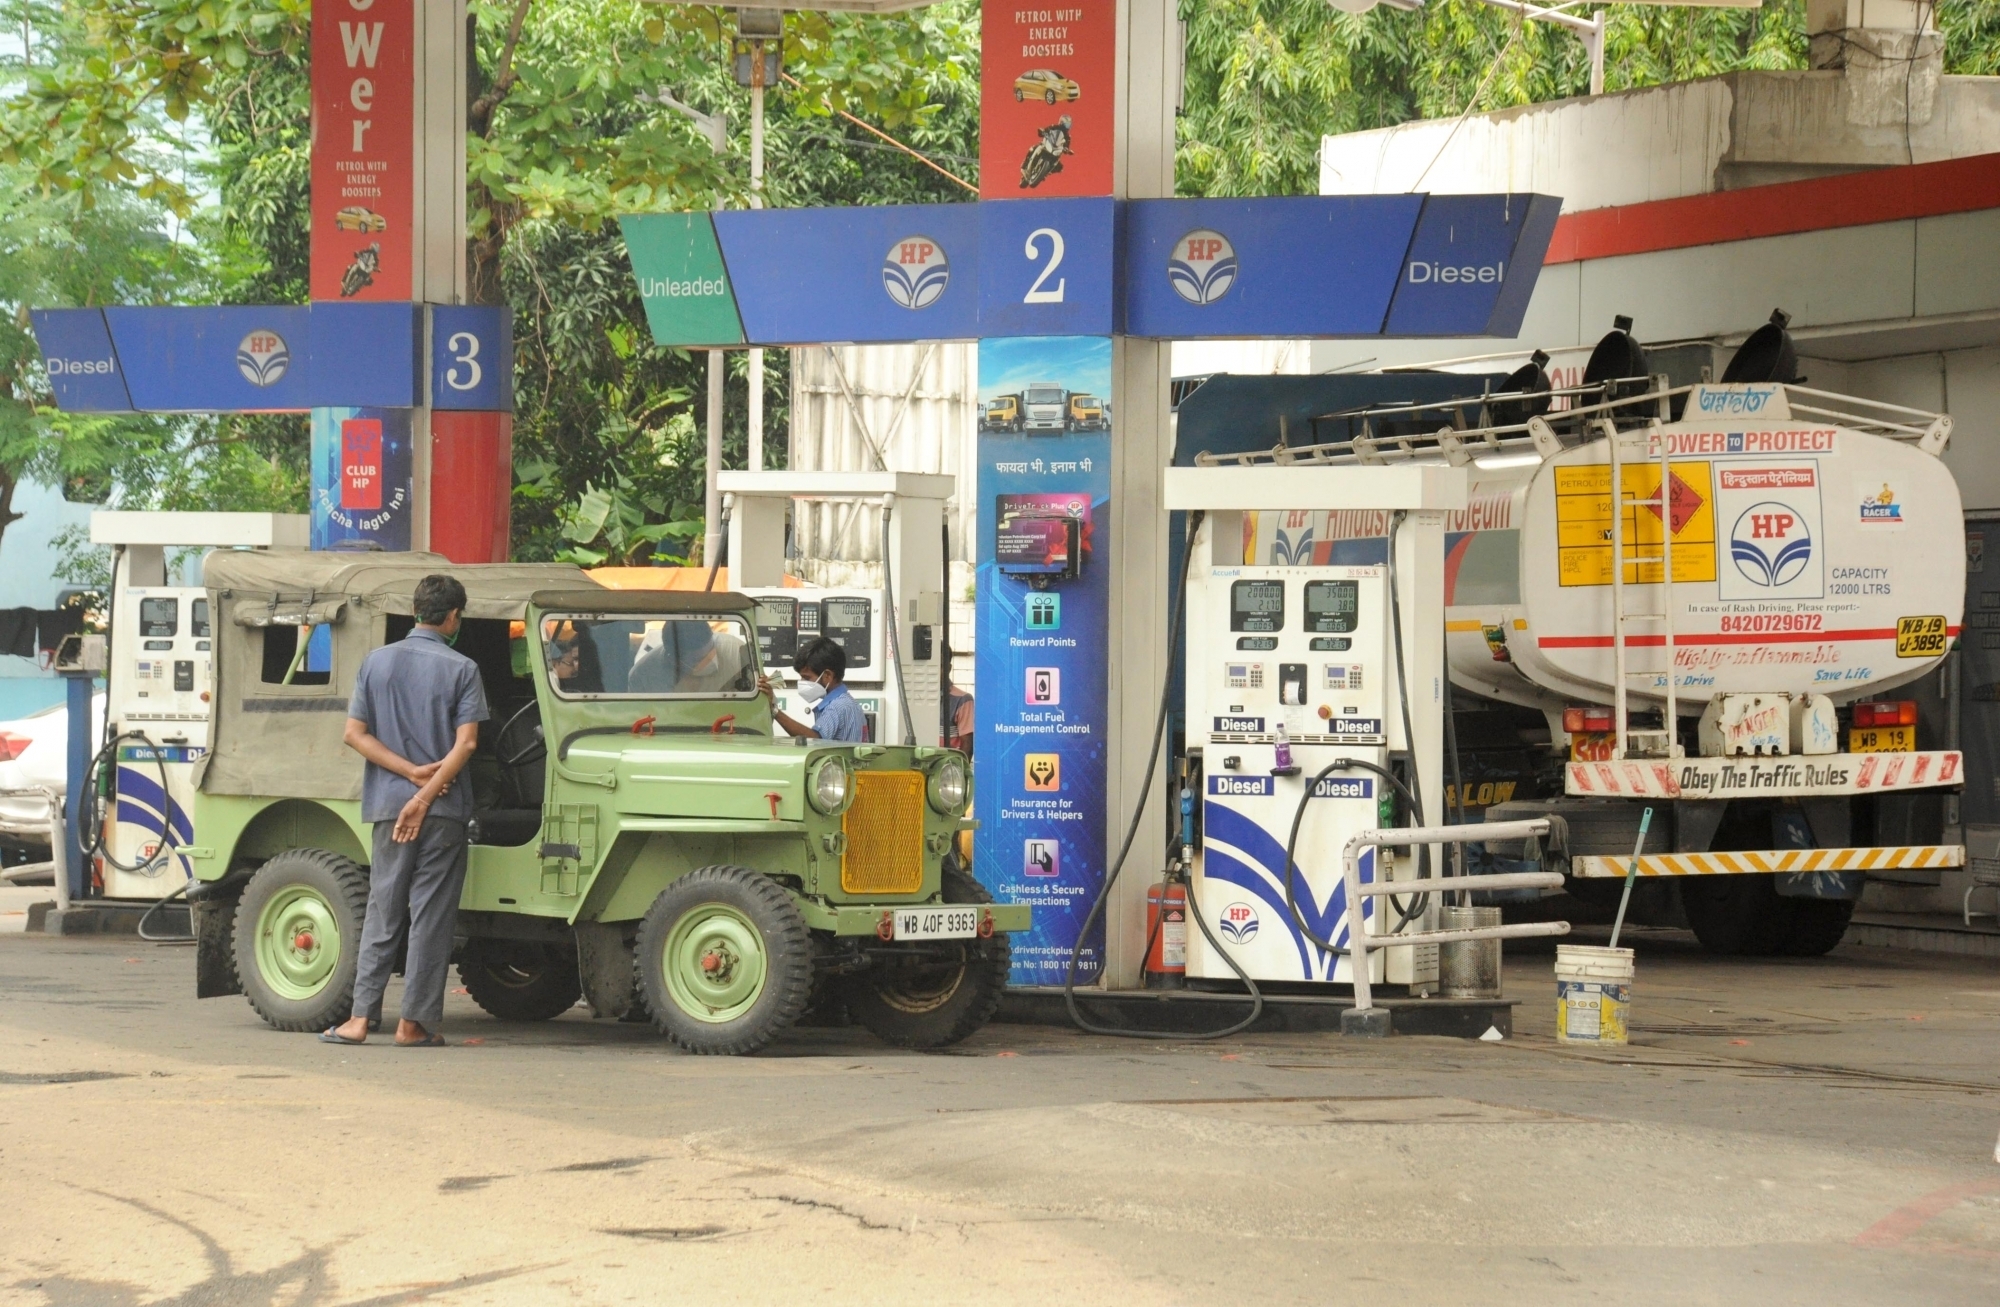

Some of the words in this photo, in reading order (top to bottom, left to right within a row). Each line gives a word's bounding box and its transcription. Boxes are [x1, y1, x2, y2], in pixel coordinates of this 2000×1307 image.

[1015, 10, 1052, 24] PETROL
[1056, 9, 1082, 22] WITH
[1029, 27, 1068, 40] ENERGY
[1022, 44, 1074, 57] BOOSTERS
[336, 161, 365, 171] PETROL
[367, 161, 387, 171] WITH
[347, 174, 377, 184] ENERGY
[342, 187, 381, 197] BOOSTERS
[900, 243, 933, 264] HP
[1187, 239, 1223, 261] HP
[1023, 228, 1066, 304] 2
[1409, 261, 1503, 284] Diesel
[641, 276, 725, 298] Unleaded
[251, 337, 277, 354] HP
[46, 356, 115, 375] Diesel
[446, 332, 482, 390] 3
[1650, 433, 1725, 454] POWER
[1729, 437, 1740, 446] TO
[1745, 431, 1836, 451] PROTECT
[346, 465, 376, 476] CLUB
[996, 462, 1028, 474] फायदा
[1050, 461, 1077, 474] इनाम
[1080, 458, 1092, 472] भी
[353, 478, 369, 488] HP
[318, 488, 353, 528] Achcha
[359, 511, 391, 531] lagta
[389, 487, 405, 510] hai
[1597, 503, 1613, 512] 120
[1672, 515, 1679, 526] 3
[1752, 514, 1793, 538] HP
[1832, 568, 1888, 580] CAPACITY
[1829, 584, 1859, 595] 12000
[1862, 584, 1890, 595] LTRS
[1688, 604, 1697, 612] In
[1722, 604, 1732, 612] of
[1734, 604, 1755, 612] Rash
[1797, 603, 1823, 612] Please
[1721, 614, 1822, 632] 8420729672
[1010, 637, 1045, 647] Reward
[1047, 637, 1076, 647] Points
[1654, 676, 1680, 687] Sae
[1683, 673, 1715, 686] Drive
[1814, 669, 1841, 681] Save
[1845, 667, 1873, 679] Life
[859, 700, 874, 711] rol
[1020, 712, 1043, 722] Total
[1045, 712, 1065, 722] Fuel
[995, 724, 1054, 735] Management
[1056, 724, 1090, 734] Control
[1221, 719, 1258, 731] Diesel
[1336, 720, 1374, 732] Diesel
[1862, 733, 1877, 747] WB
[1890, 731, 1904, 745] 19
[1681, 766, 1719, 793] Obey
[1721, 766, 1746, 788] The
[1750, 764, 1802, 787] Traffic
[1805, 763, 1848, 786] Rules
[1218, 778, 1265, 794] Diesel
[1315, 781, 1363, 797] Diesel
[1011, 798, 1057, 808] Insurance
[1059, 799, 1073, 808] for
[1001, 809, 1035, 819] Drivers
[1037, 810, 1044, 819] &
[1046, 810, 1083, 821] Helpers
[999, 884, 1041, 894] Cashless
[1043, 884, 1050, 894] &
[1052, 885, 1085, 895] Secure
[1010, 896, 1070, 906] Transactions
[1230, 909, 1250, 920] HP
[905, 915, 918, 933] WB
[923, 914, 943, 933] 40F
[948, 913, 975, 932] 9363
[1024, 961, 1037, 969] No:
[1040, 961, 1058, 970] 1800
[1078, 961, 1097, 970] 9811
